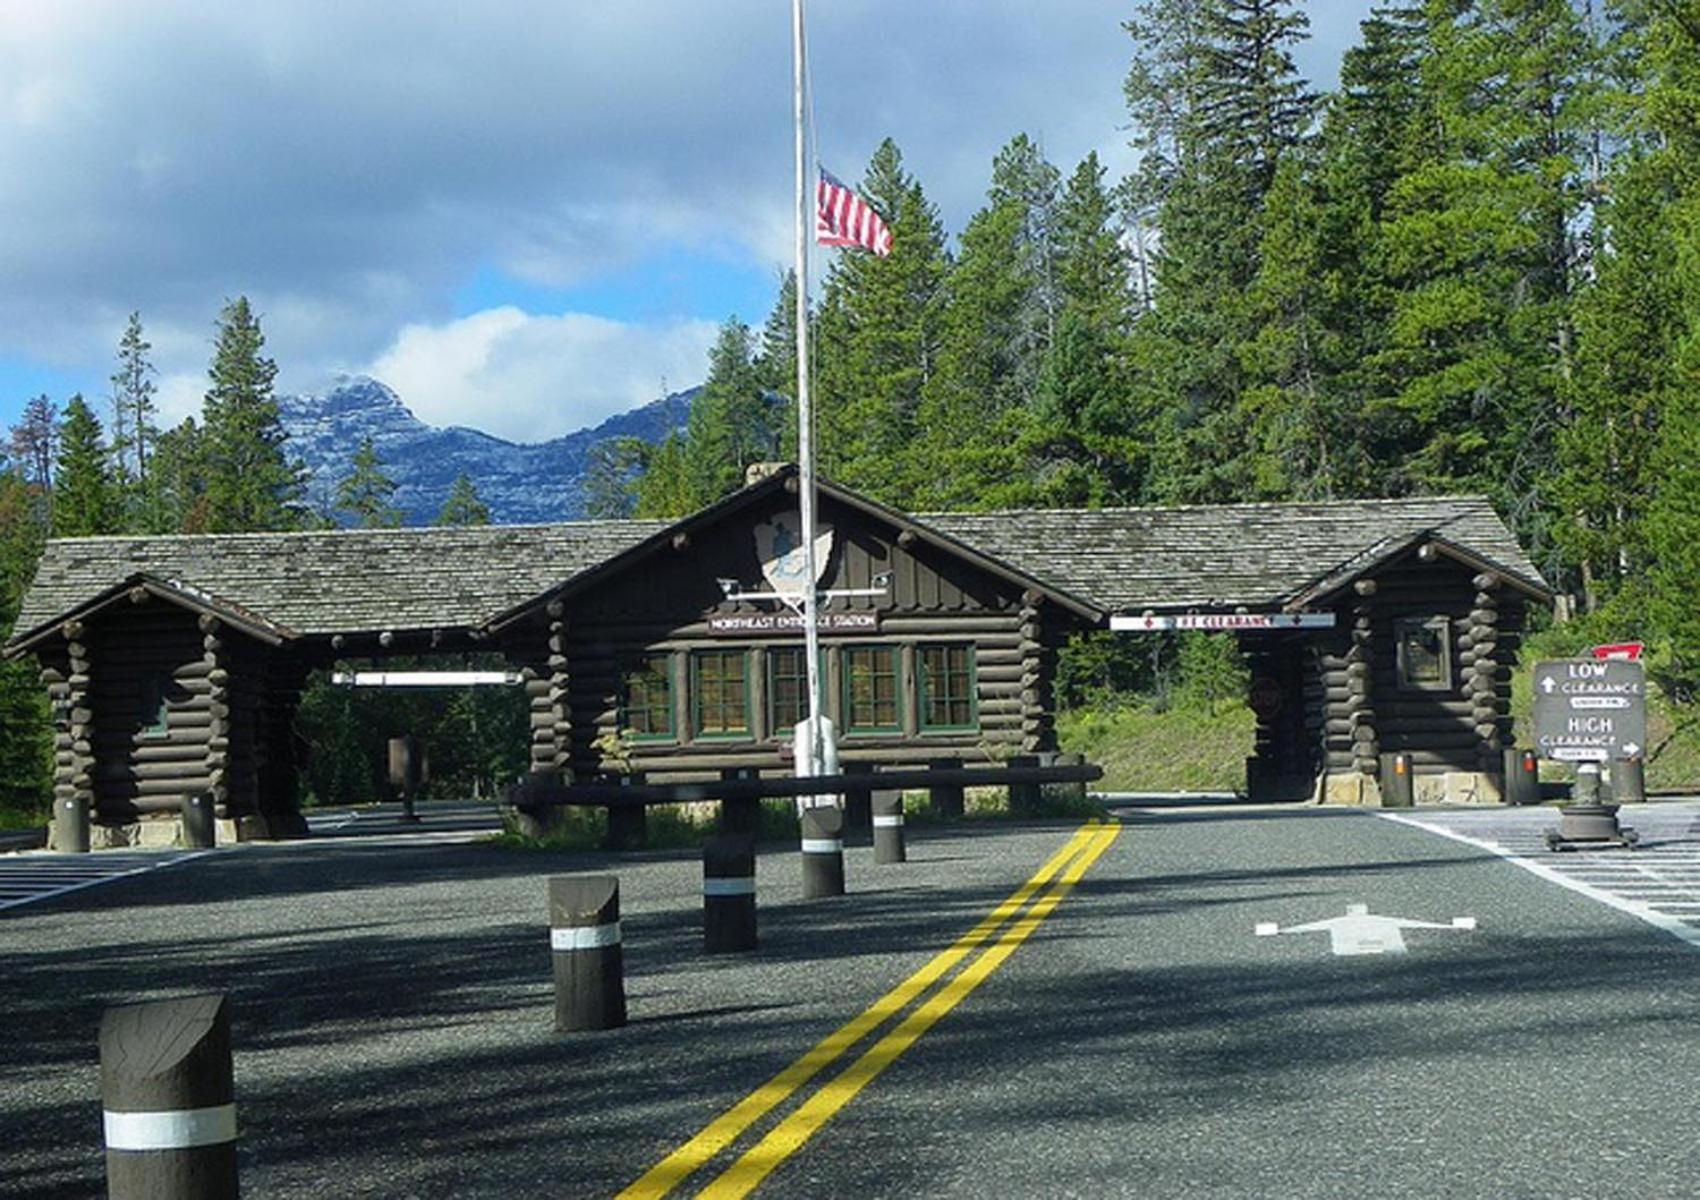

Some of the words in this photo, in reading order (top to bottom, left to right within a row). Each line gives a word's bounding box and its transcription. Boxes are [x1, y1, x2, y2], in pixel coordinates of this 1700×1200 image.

[711, 617, 774, 630] NORTHEAST
[778, 615, 830, 629] ENTRCE
[833, 614, 875, 627] STATION
[1569, 663, 1608, 678] LOW
[1561, 682, 1639, 694] CLEARANCE
[1568, 717, 1613, 732] HIGH
[1539, 735, 1616, 746] CLEARANCE
